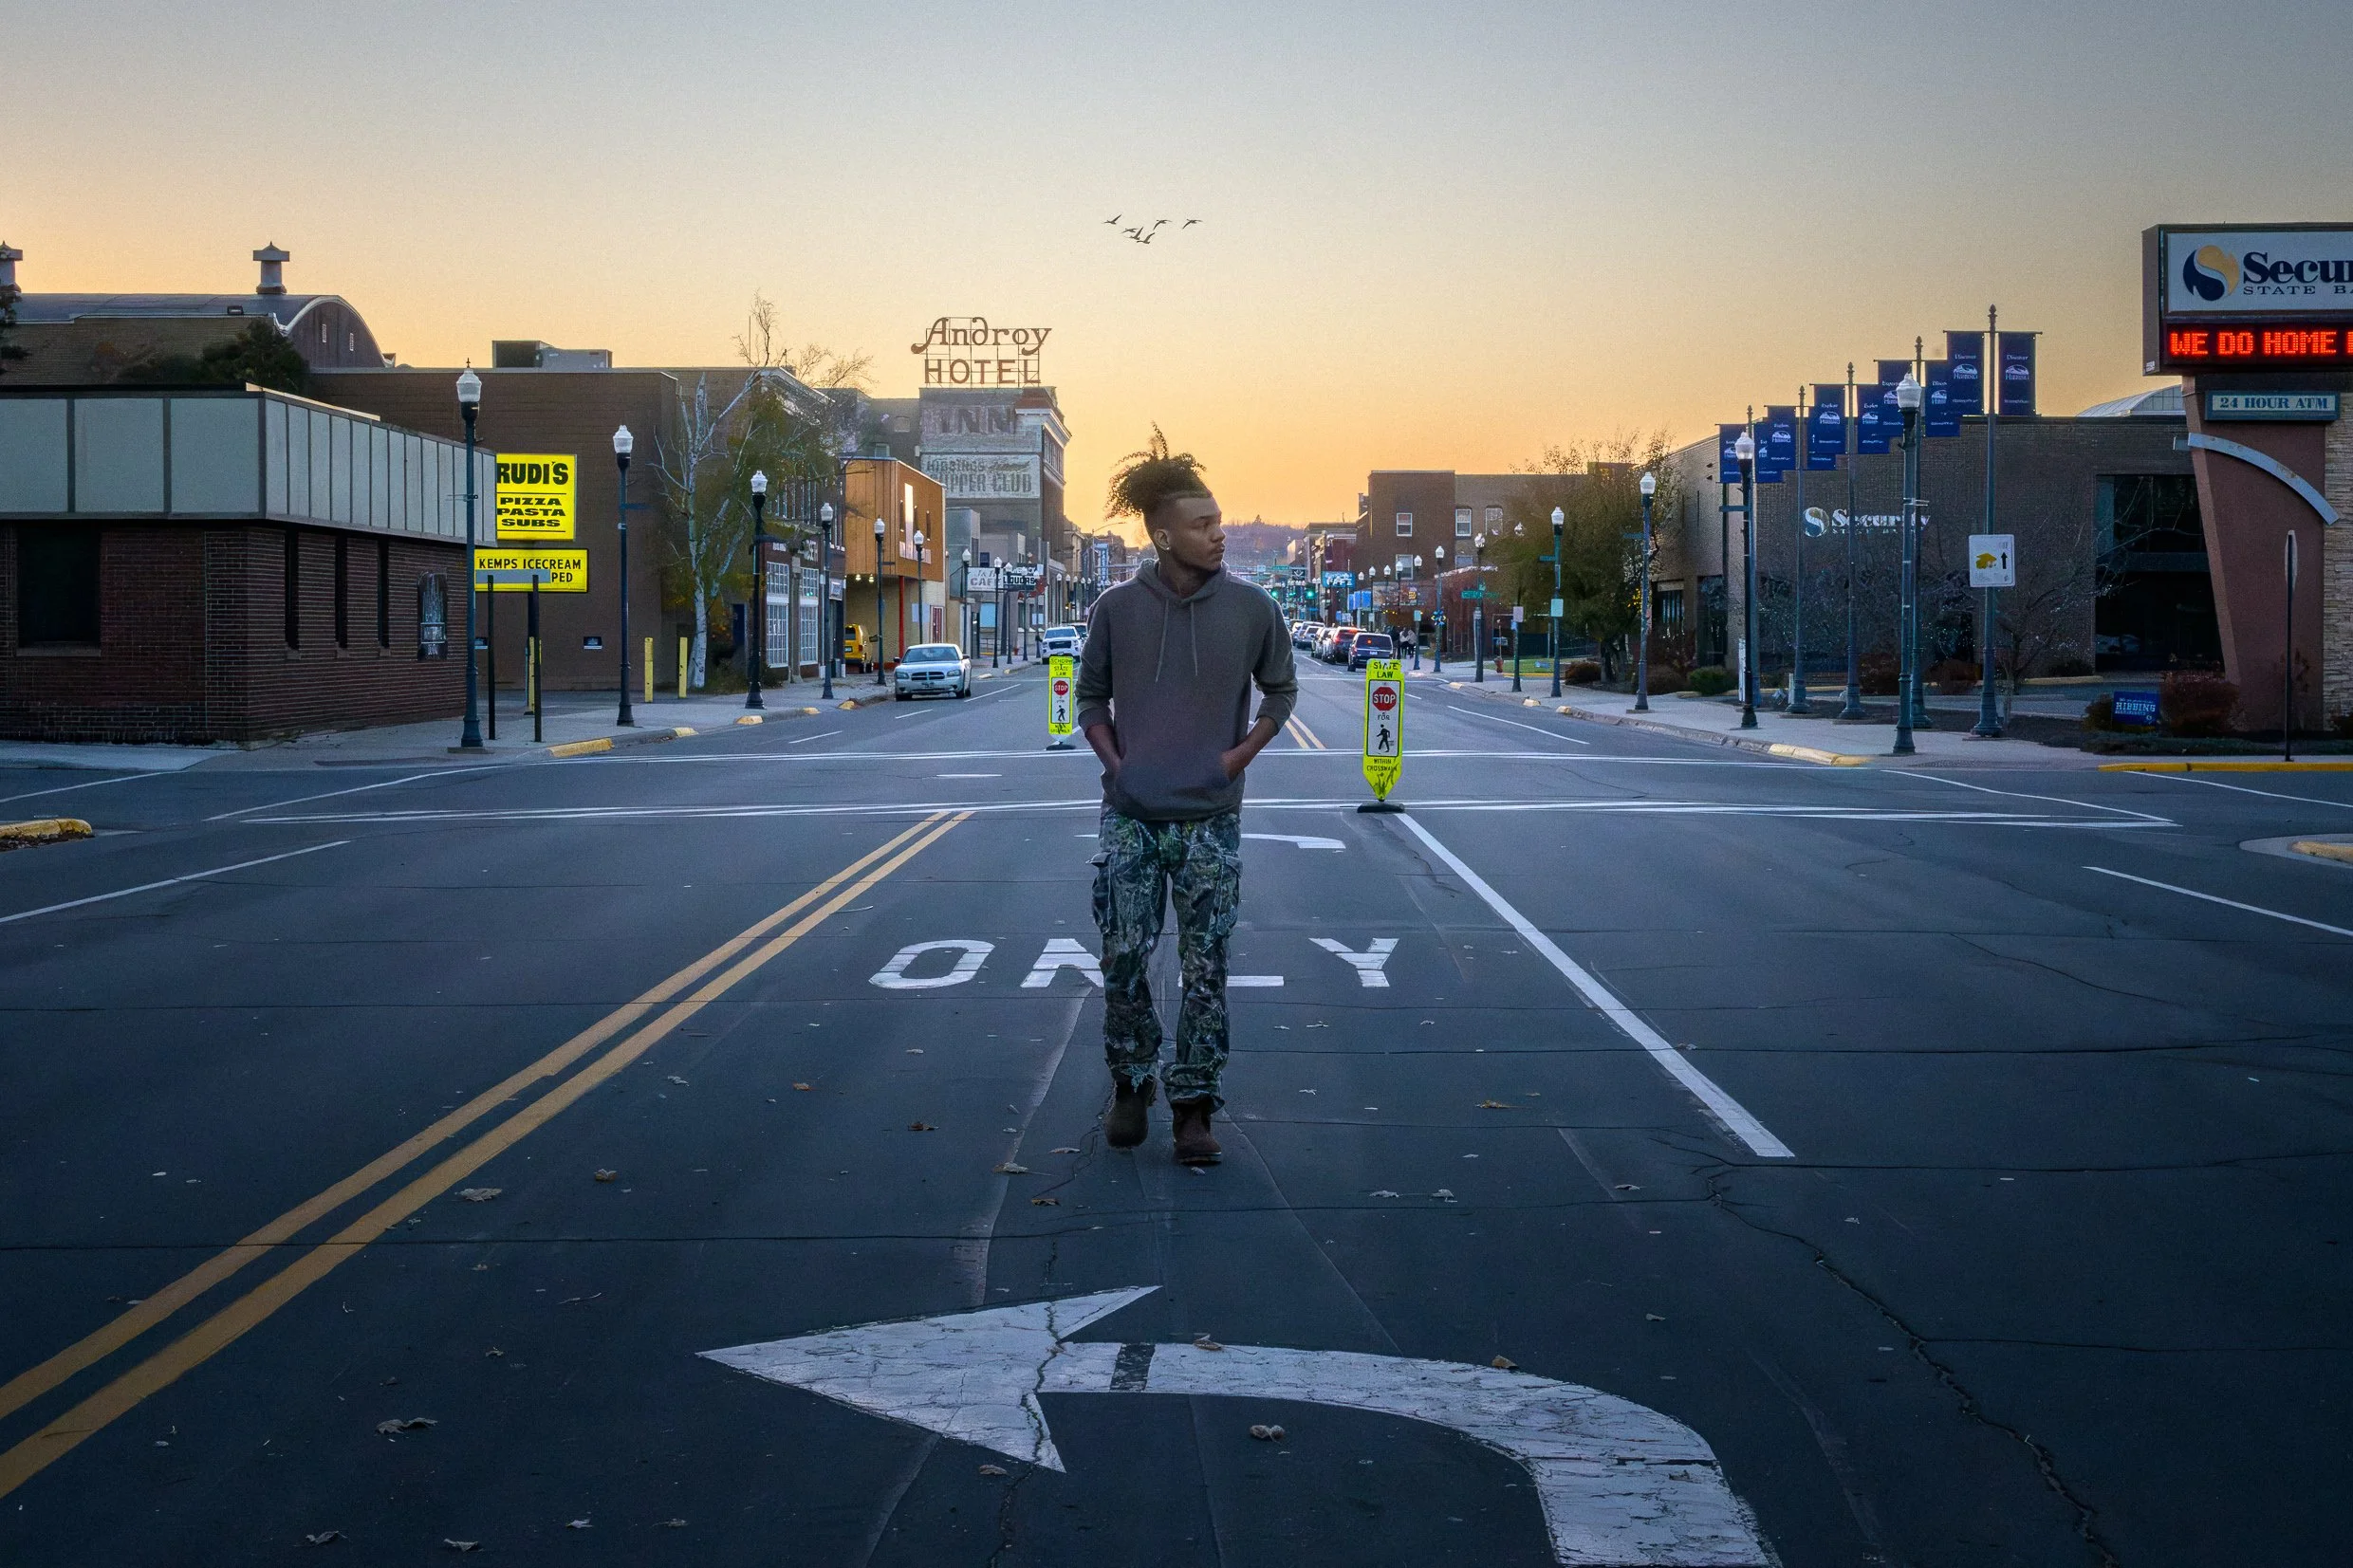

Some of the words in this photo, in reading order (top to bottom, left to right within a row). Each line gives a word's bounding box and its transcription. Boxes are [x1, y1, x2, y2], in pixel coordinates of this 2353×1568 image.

[2243, 286, 2315, 295] STATE
[2334, 286, 2353, 294] B
[911, 317, 1052, 356] Androy
[2171, 332, 2209, 355] WE
[2218, 331, 2254, 355] DO
[2264, 331, 2337, 355] HOME
[924, 359, 1041, 384] HOTEL
[2219, 397, 2239, 409] 24
[2244, 397, 2290, 409] HOUR
[2296, 397, 2329, 409] ATM
[496, 461, 569, 486] RUDI'S
[500, 497, 562, 506] PIZZA
[496, 507, 566, 517] PASTA
[501, 518, 561, 527] SUBS
[478, 558, 518, 569] KEMPS
[523, 558, 582, 569] ICECREAM
[1373, 661, 1399, 670] STATE
[1377, 671, 1394, 679] LAW
[1373, 693, 1396, 704] STOP
[2115, 702, 2157, 712] HIBBING
